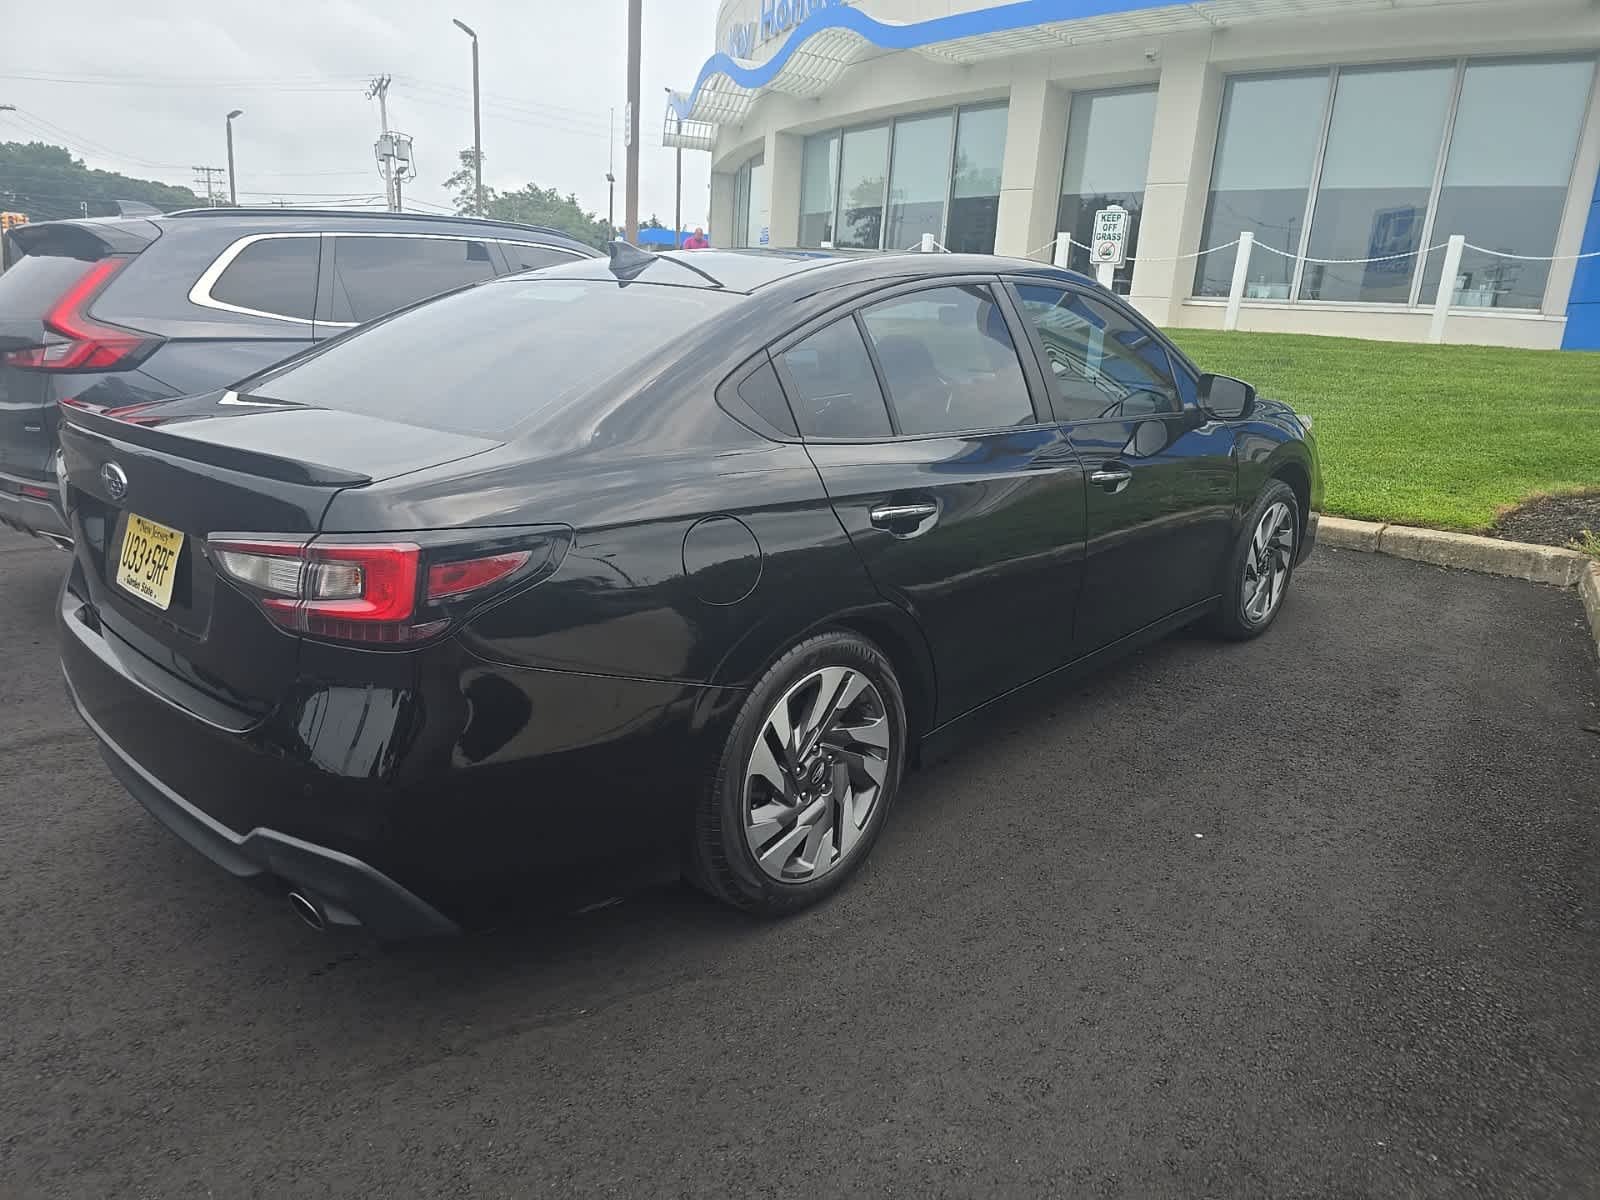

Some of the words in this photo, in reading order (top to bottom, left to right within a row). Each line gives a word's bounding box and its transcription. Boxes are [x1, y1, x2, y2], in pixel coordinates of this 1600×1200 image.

[759, 0, 842, 41] Hon
[1101, 214, 1121, 222] KEEP
[1103, 224, 1117, 232] OFF
[1096, 233, 1121, 241] GRASS
[122, 532, 148, 573] U33
[140, 582, 154, 597] State
